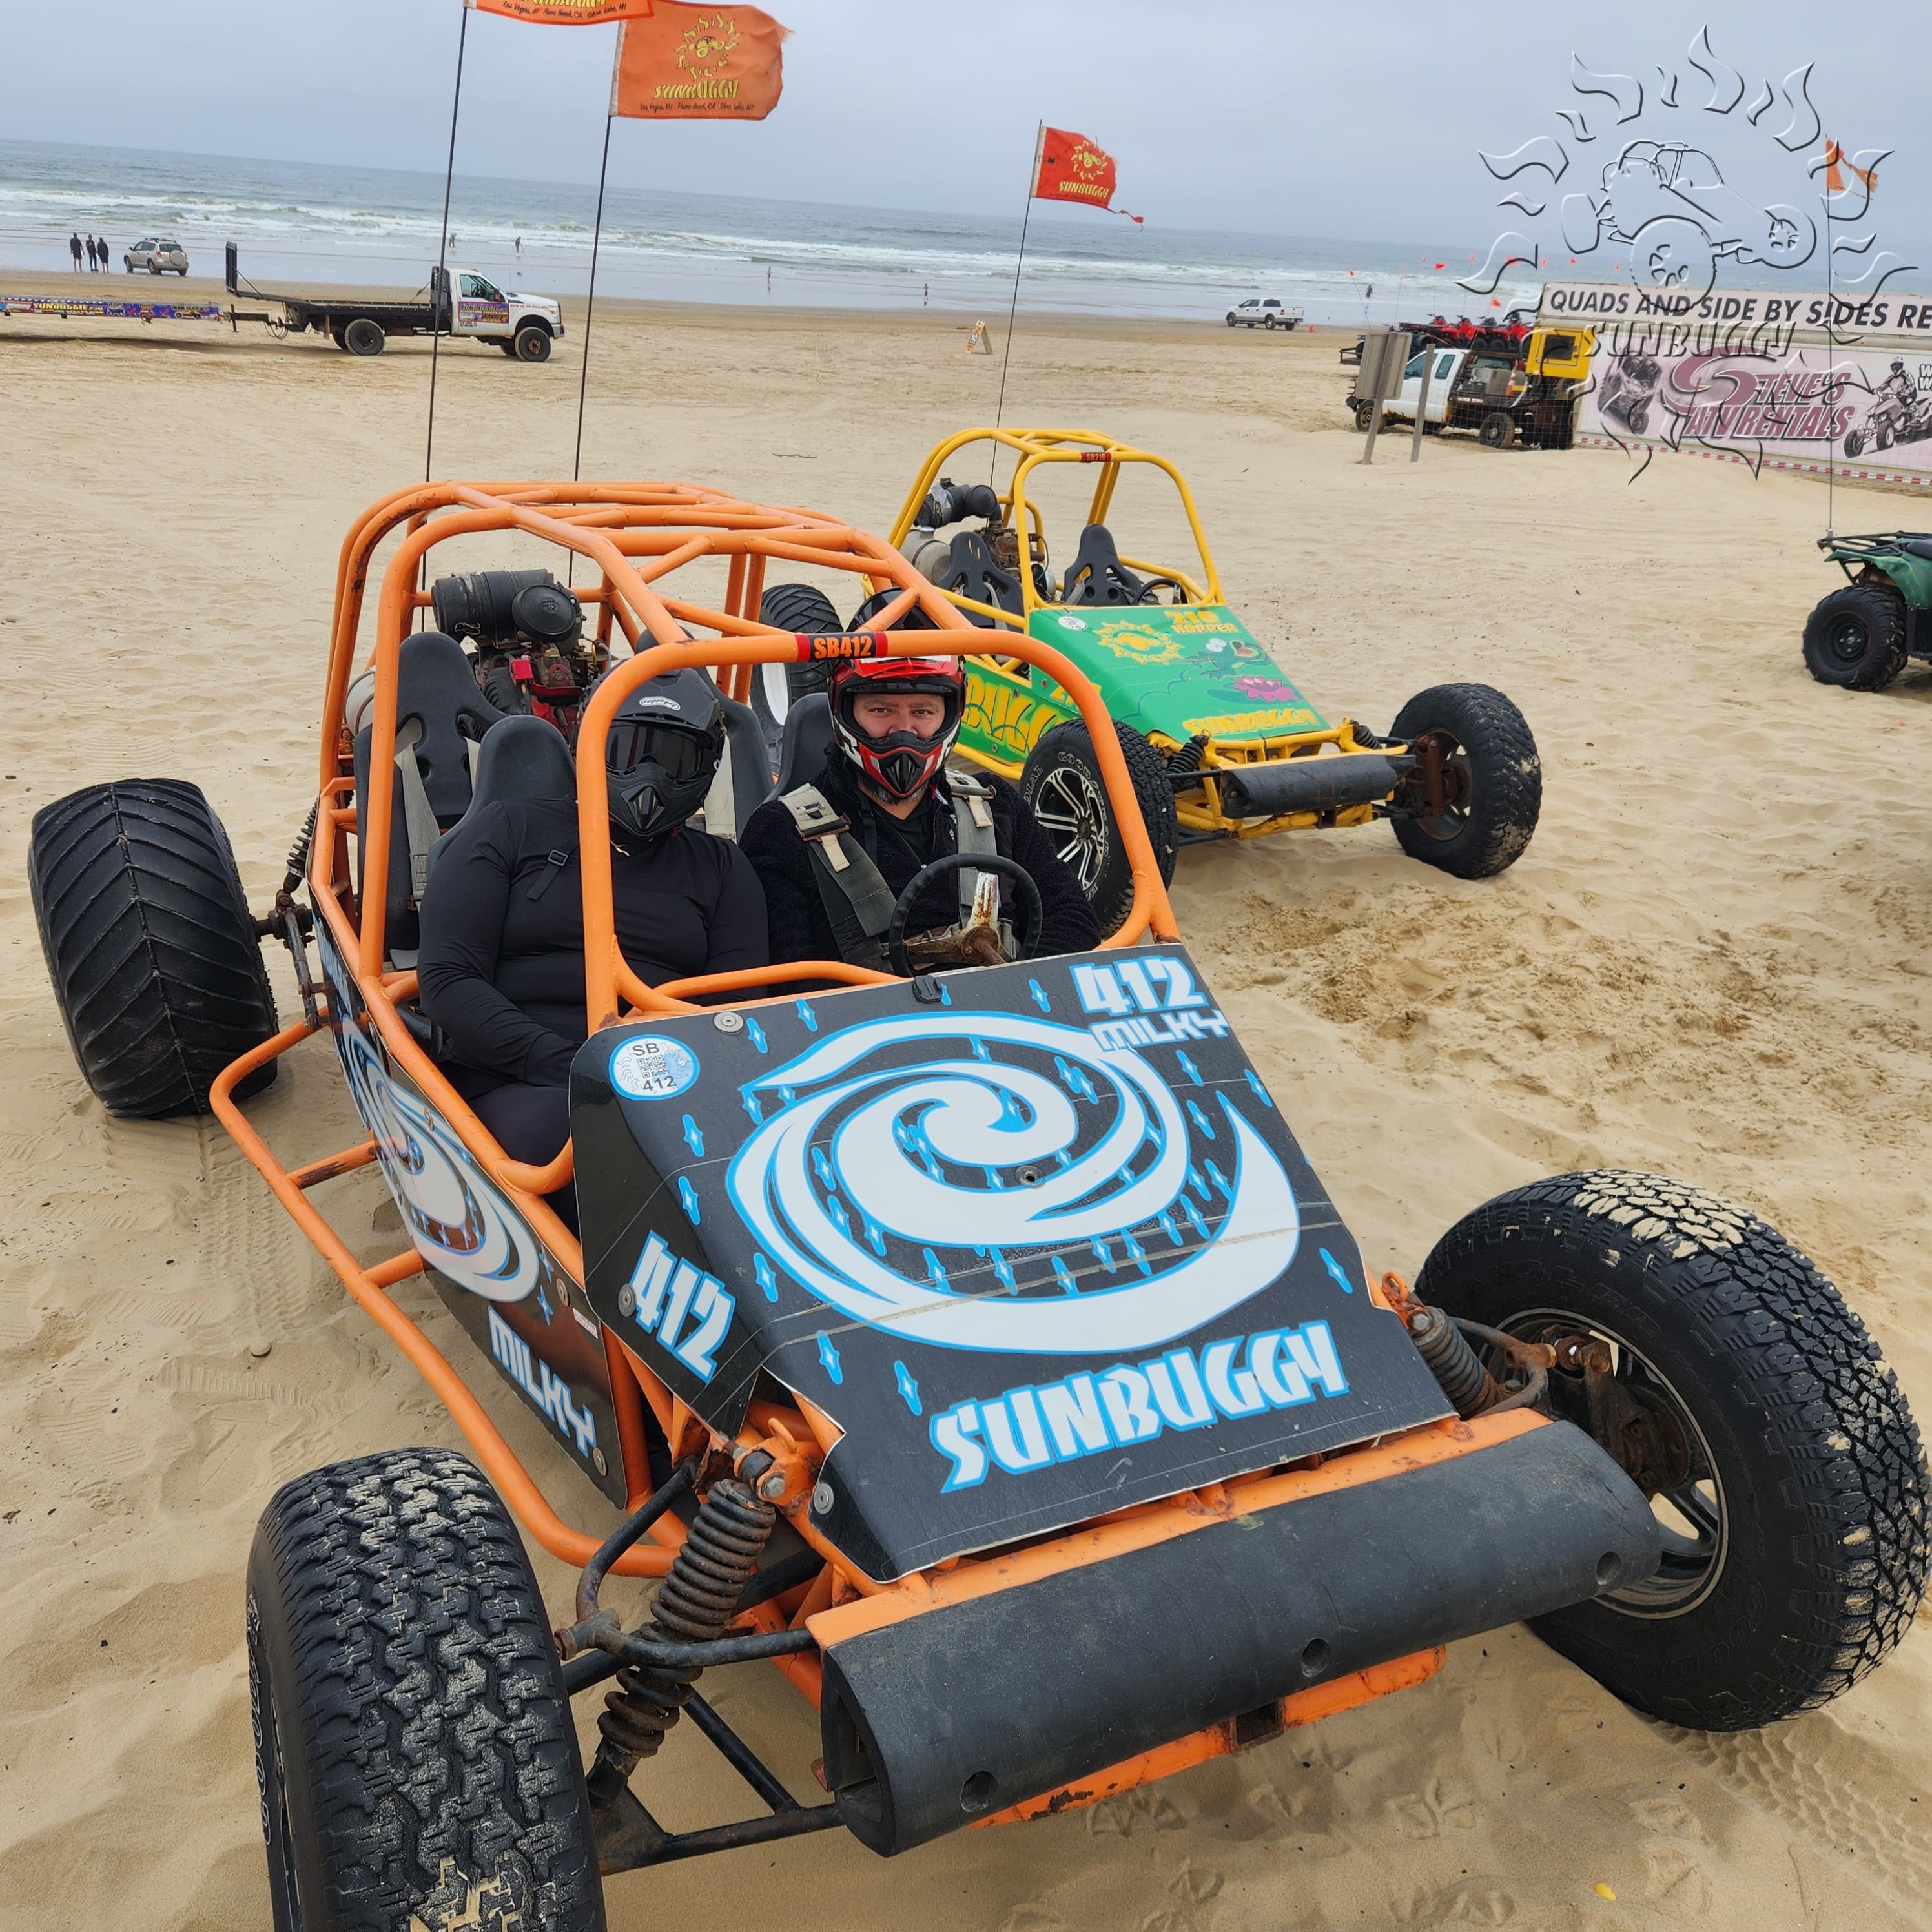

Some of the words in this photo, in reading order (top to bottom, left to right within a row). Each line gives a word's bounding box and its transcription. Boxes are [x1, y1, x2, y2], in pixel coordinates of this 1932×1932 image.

[654, 79, 740, 99] SUNBUGGY
[1059, 181, 1110, 198] SUNBUGGY
[1550, 289, 1629, 314] QUADS
[1635, 294, 1690, 317] AND
[1698, 296, 1758, 321] SIDE
[1764, 300, 1802, 322] BY
[1805, 300, 1889, 327] SIDES
[1897, 304, 1932, 329] RE
[1680, 404, 1742, 440] ATV
[1733, 406, 1856, 441] RENTALS
[1164, 611, 1220, 624] 210
[814, 635, 872, 659] SB412
[1182, 708, 1321, 735] SUNBUGGY
[1069, 956, 1209, 1016] 412
[1089, 1009, 1229, 1052] MILKY
[632, 1042, 660, 1056] SB
[642, 1075, 677, 1092] 412
[629, 1229, 737, 1385] 412
[488, 1305, 597, 1458] MILKY
[929, 1319, 1349, 1494] SUNBUGGY
